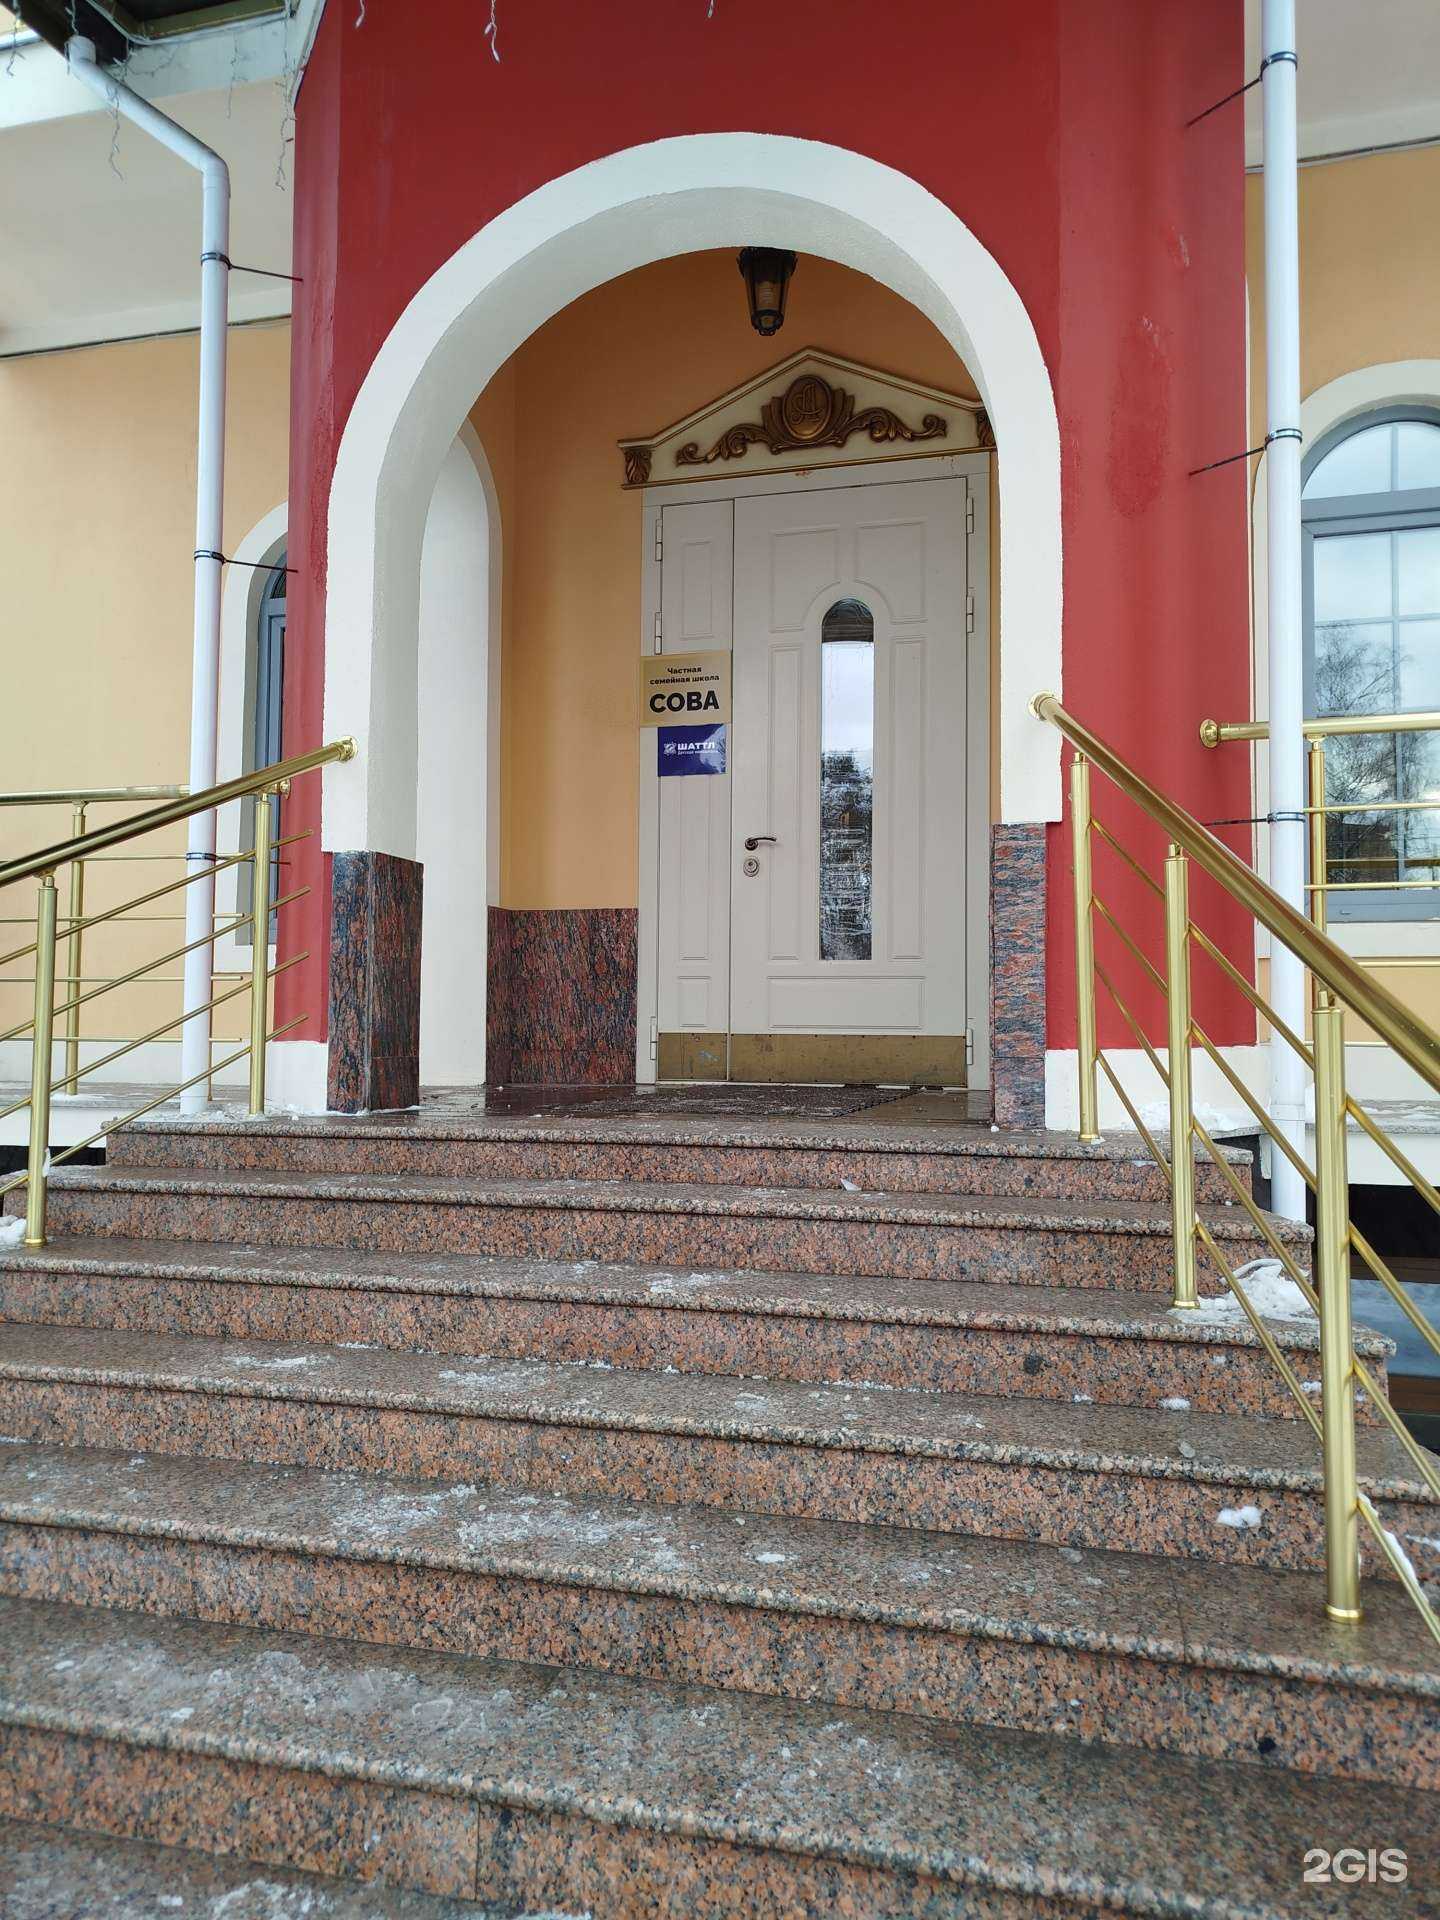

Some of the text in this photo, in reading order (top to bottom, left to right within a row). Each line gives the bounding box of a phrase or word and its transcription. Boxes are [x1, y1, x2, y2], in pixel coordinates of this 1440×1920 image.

[667, 667, 702, 675] Частная
[649, 675, 720, 685] семейная школа
[649, 690, 720, 713] СОВА
[677, 742, 716, 751] ШАТТЛ
